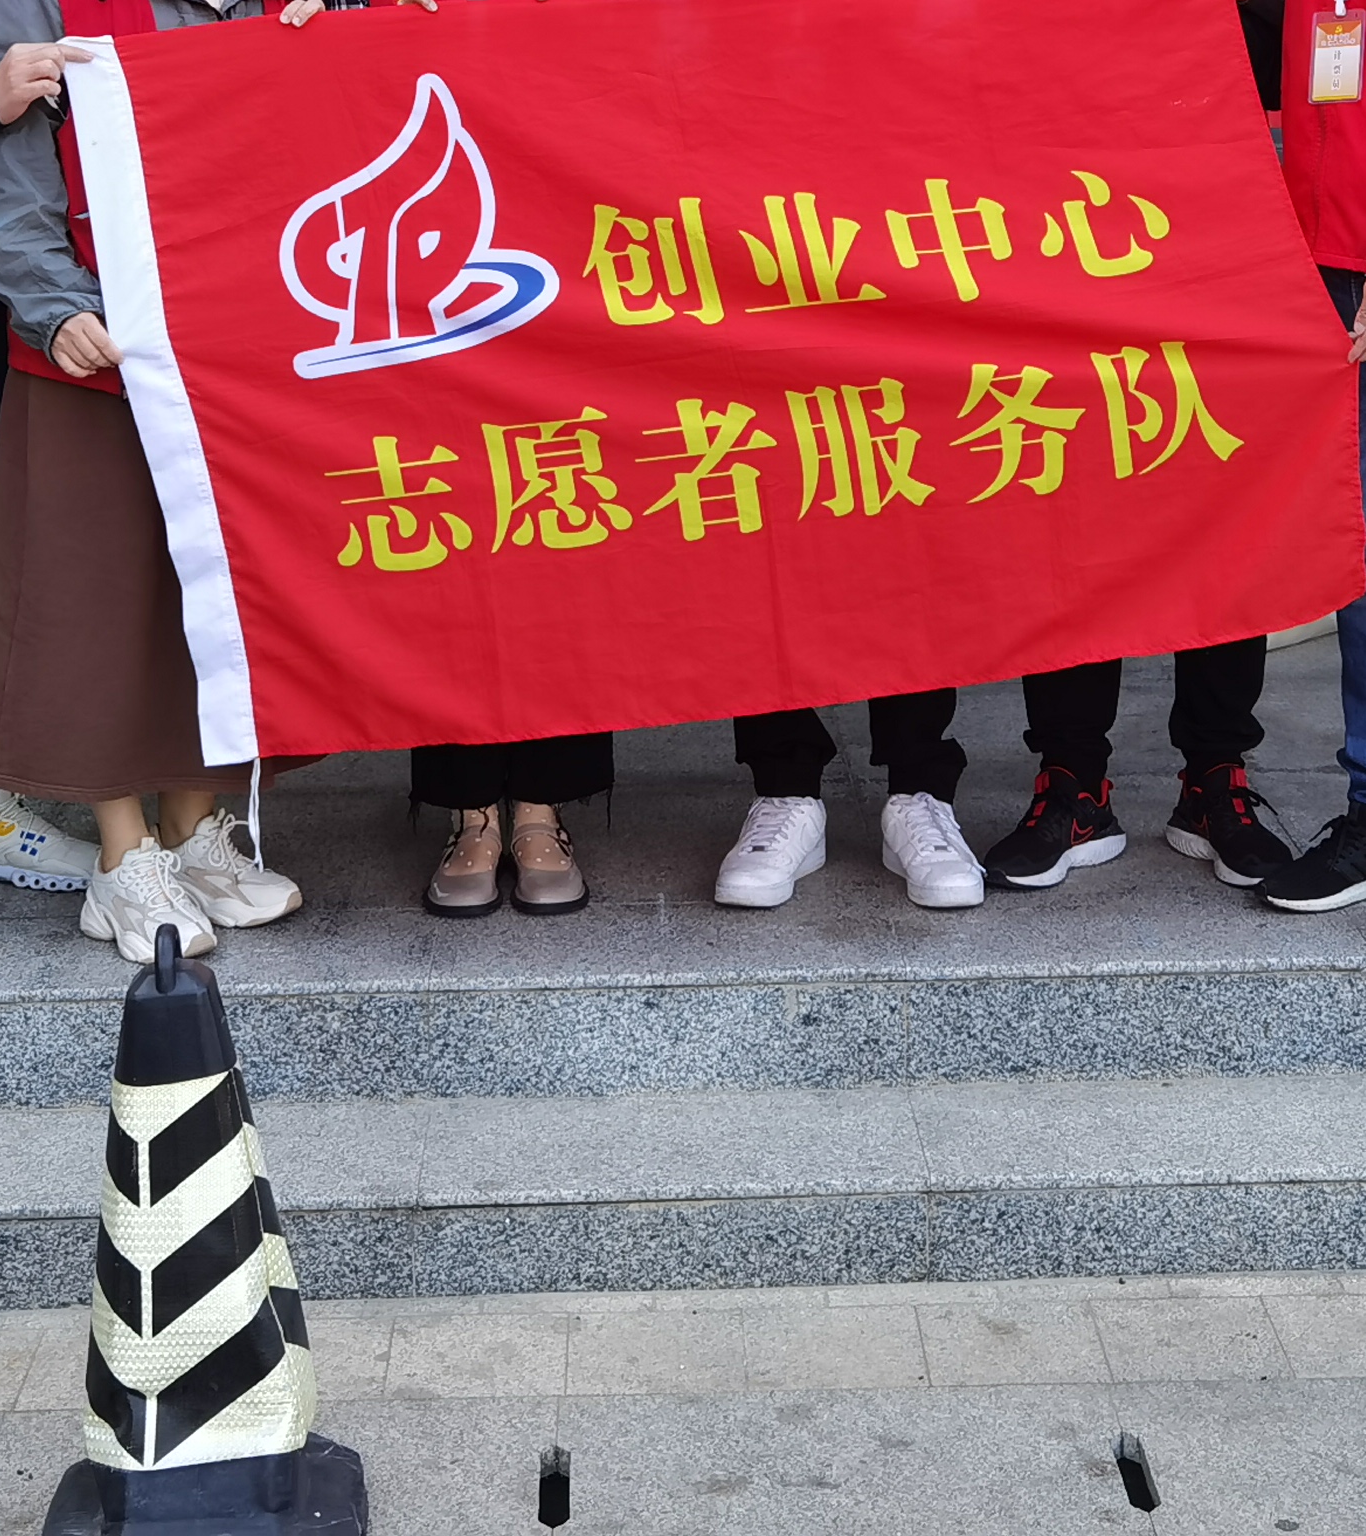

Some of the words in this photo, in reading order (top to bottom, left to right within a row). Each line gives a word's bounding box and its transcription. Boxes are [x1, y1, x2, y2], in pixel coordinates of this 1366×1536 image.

[581, 169, 1172, 328] 创业中心
[325, 340, 1245, 573] 志愿者服务队
